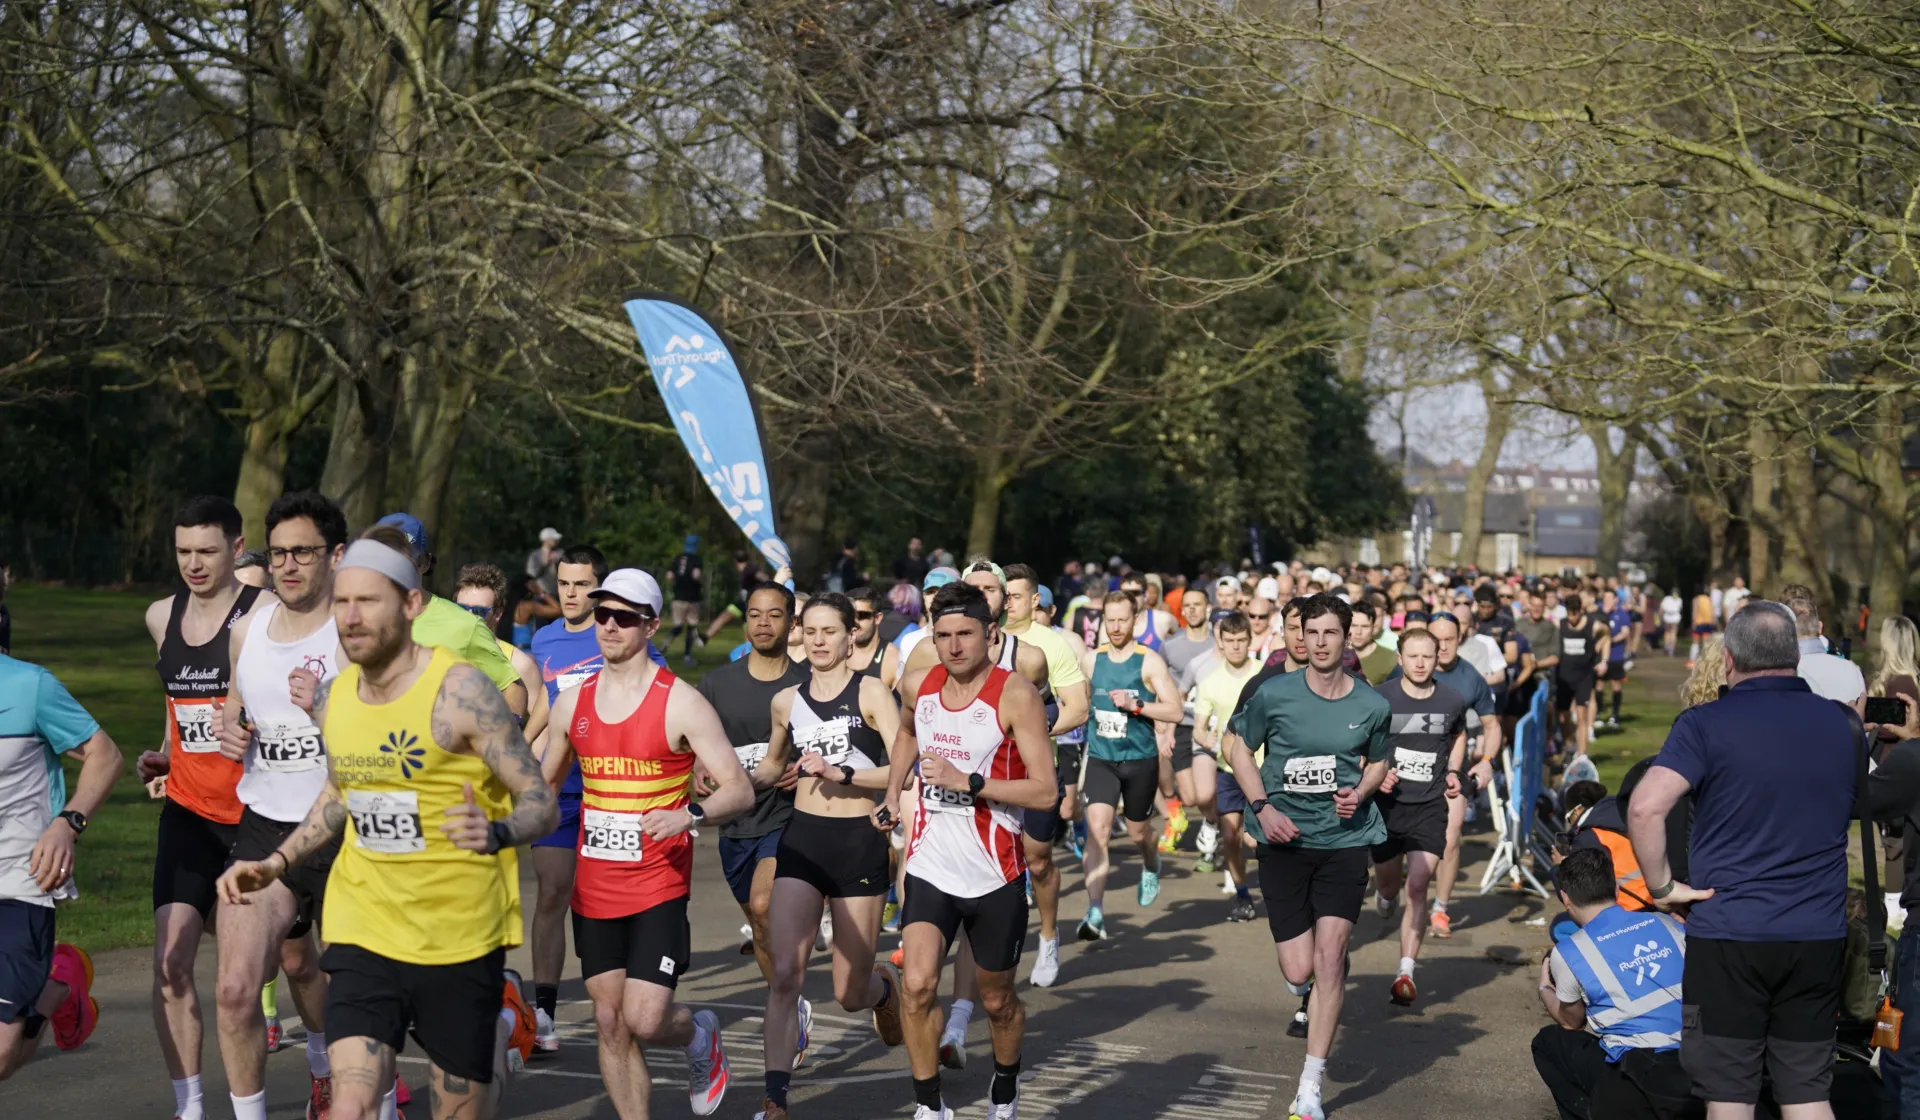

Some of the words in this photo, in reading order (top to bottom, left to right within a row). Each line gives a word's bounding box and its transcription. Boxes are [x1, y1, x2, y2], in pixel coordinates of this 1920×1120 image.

[227, 608, 243, 629] soar
[175, 665, 219, 680] Marshall
[167, 682, 190, 691] Milton
[191, 682, 220, 692] Keynes
[179, 721, 218, 742] 710
[933, 732, 962, 746] WARE
[259, 735, 320, 760] 7799
[922, 745, 971, 761] JOGGERS
[578, 756, 663, 776] ERPENTINE
[1396, 759, 1433, 775] 7566
[1283, 768, 1335, 785] 7640
[350, 812, 418, 839] 7158
[585, 826, 640, 850] 7988
[1596, 929, 1617, 942] Event
[1615, 918, 1656, 936] Photographer
[1619, 946, 1673, 972] RunThrough
